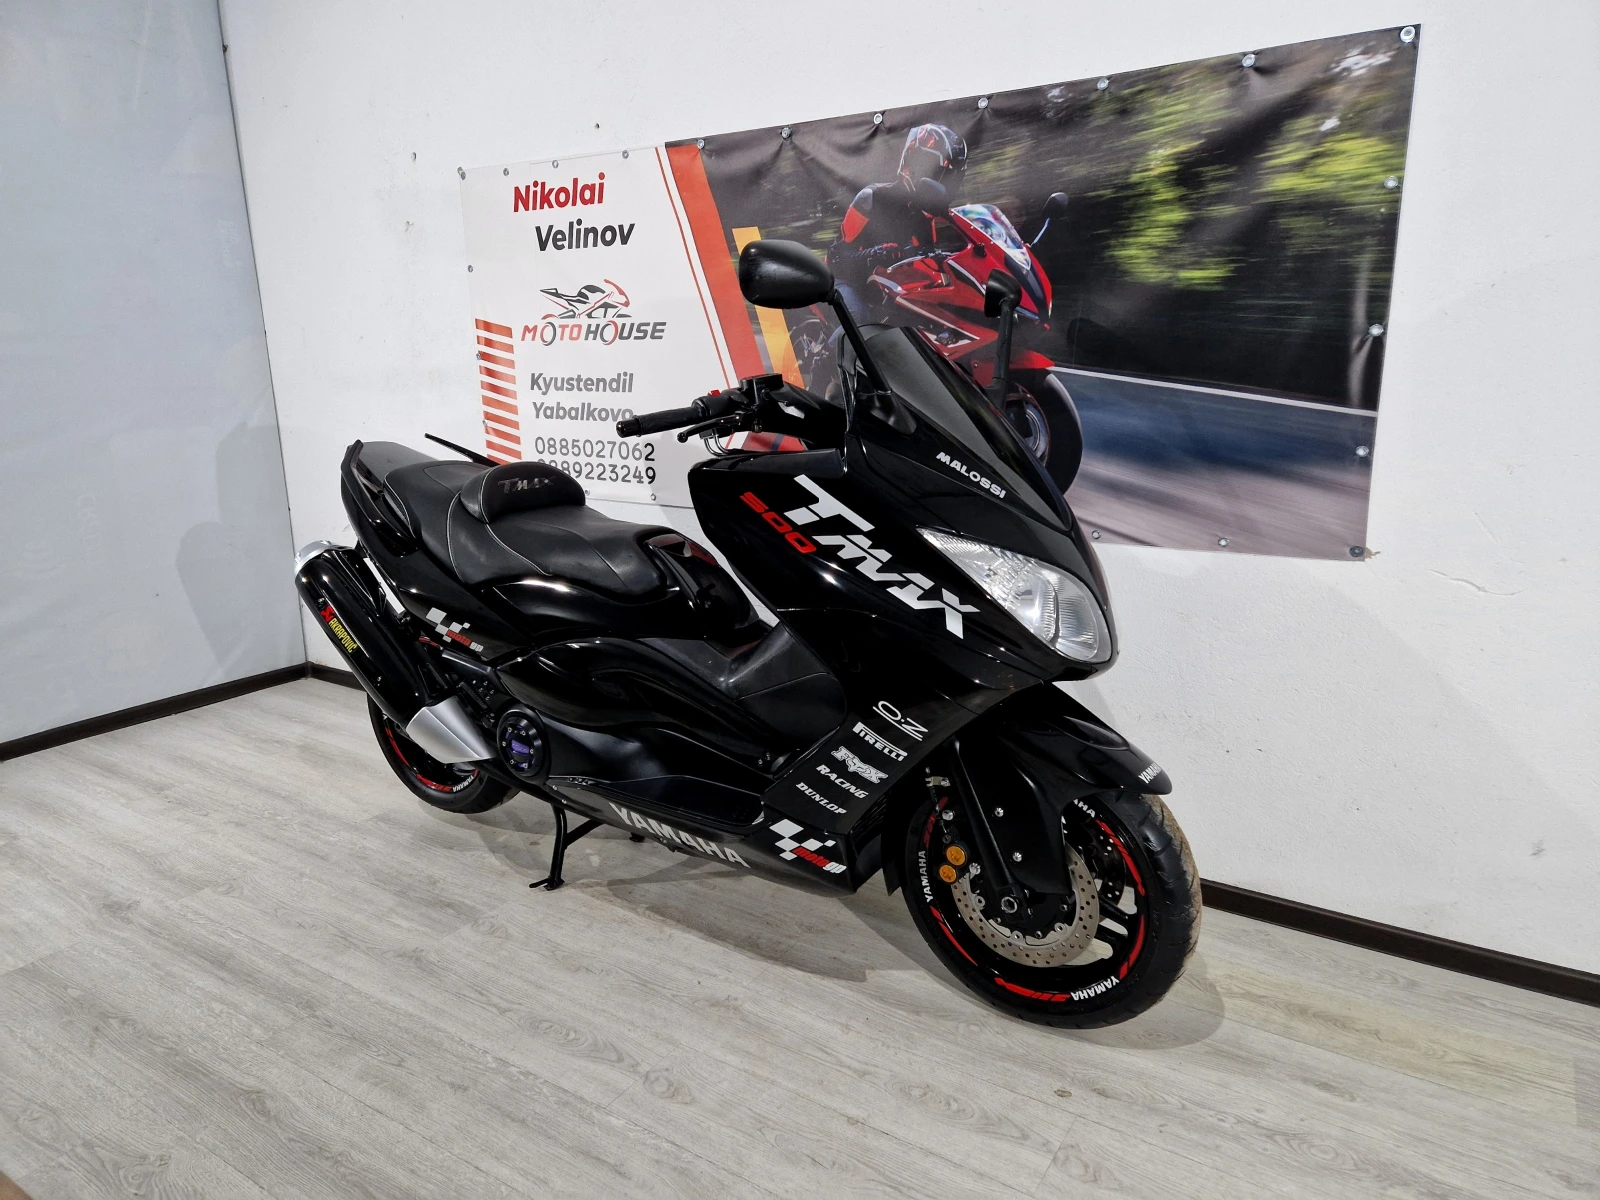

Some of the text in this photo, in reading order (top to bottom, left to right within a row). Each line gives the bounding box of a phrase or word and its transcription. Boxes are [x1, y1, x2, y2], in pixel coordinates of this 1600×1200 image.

[513, 172, 606, 212] Nikolai
[535, 218, 635, 251] Velinov
[530, 371, 634, 395] Kyustendil
[532, 402, 634, 422] Yabalkovo
[534, 436, 656, 462] 0885027062
[936, 451, 1006, 499] MALOSSI
[739, 491, 817, 554] 500
[783, 474, 981, 640] TMAX
[852, 721, 908, 762] PIRELLI
[796, 782, 847, 814] DUNLOP
[815, 764, 870, 799] RACING
[609, 802, 751, 869] YAMAHA
[918, 850, 934, 903] YAMAHA
[1070, 975, 1120, 1001] YAMAHA
